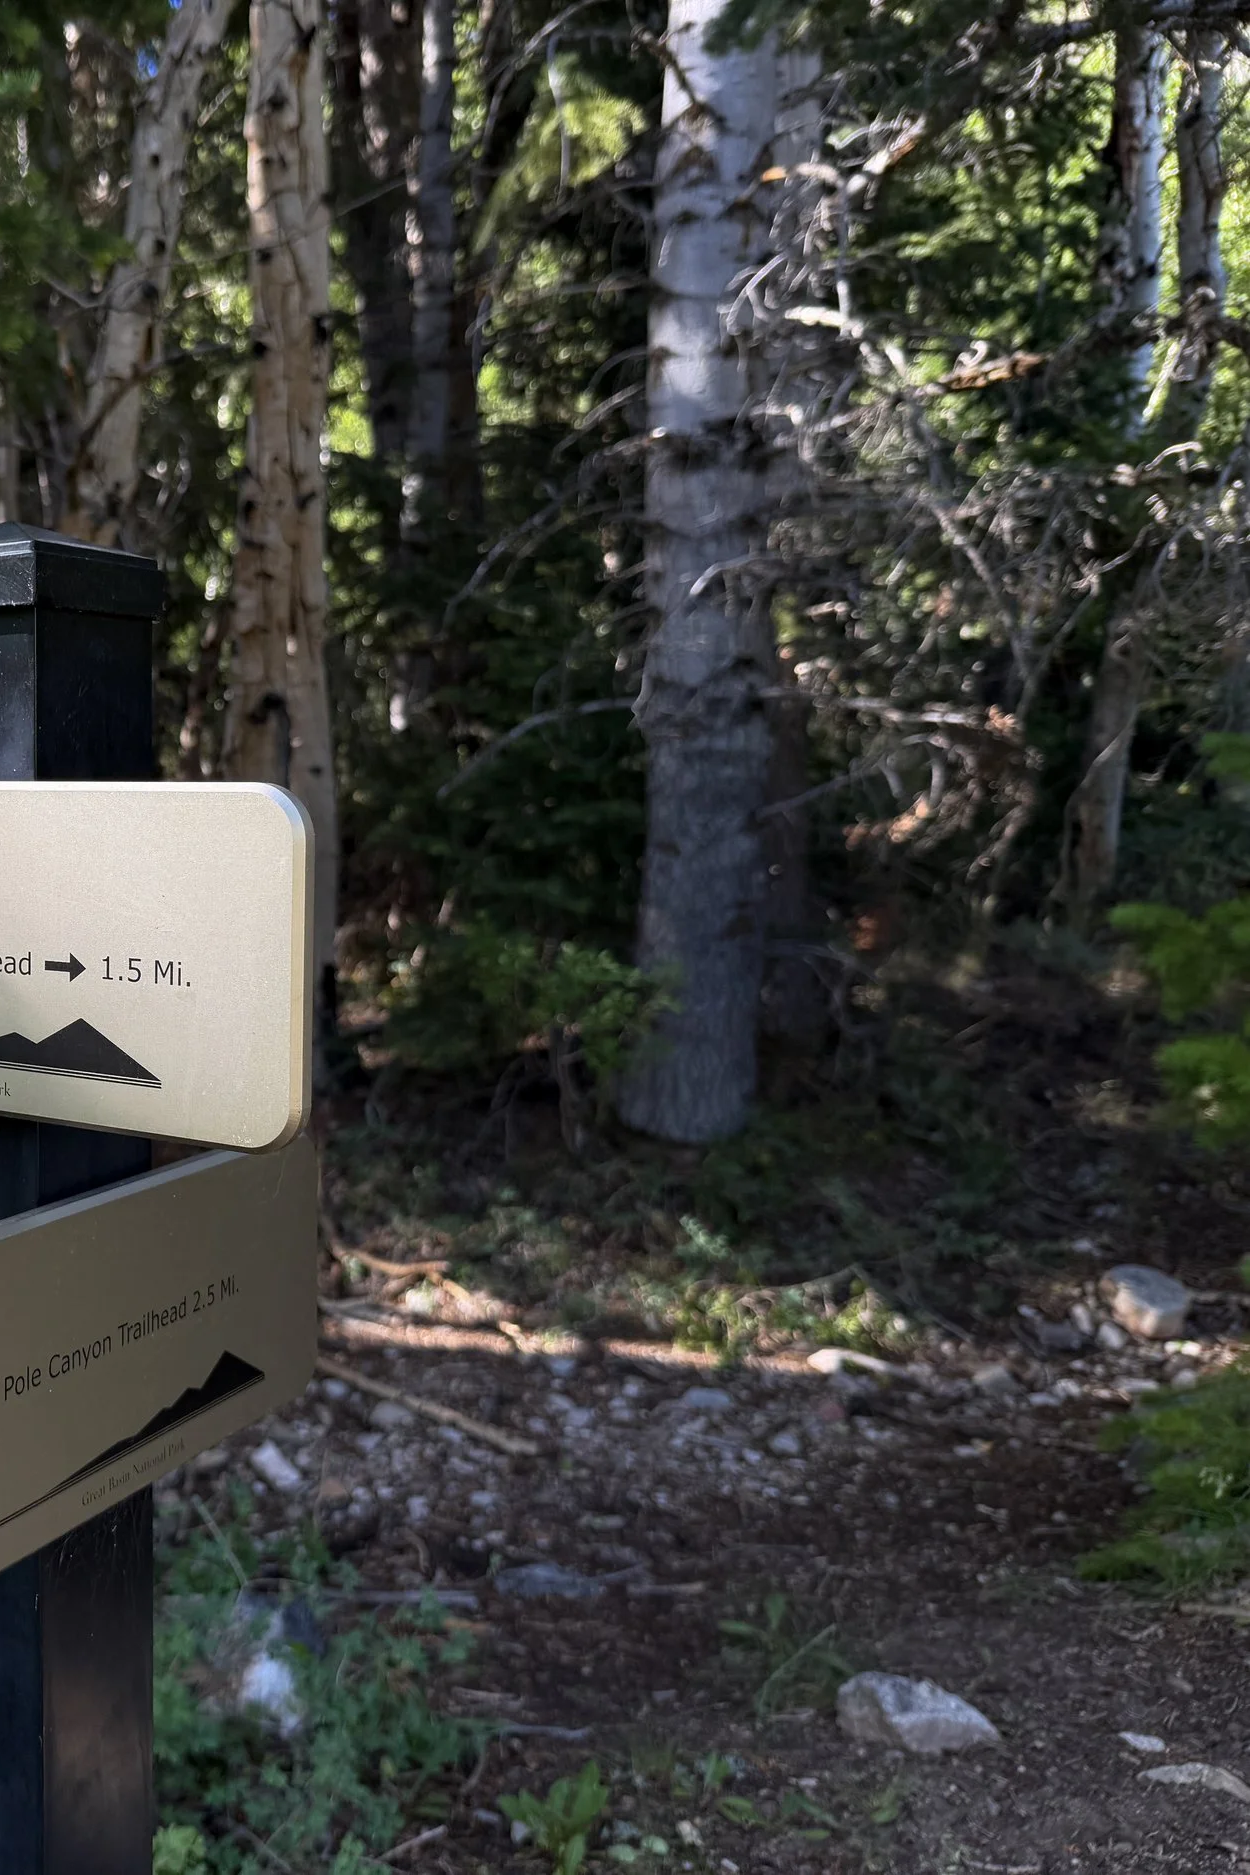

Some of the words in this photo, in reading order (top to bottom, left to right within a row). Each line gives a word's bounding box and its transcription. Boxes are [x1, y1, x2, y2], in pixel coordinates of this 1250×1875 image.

[102, 956, 142, 983] 1.5
[154, 959, 191, 987] Mi.
[4, 1366, 41, 1401] Pole
[48, 1335, 111, 1379] Canyon
[118, 1296, 187, 1347] Trailhead
[193, 1284, 215, 1313] 2.5
[221, 1275, 239, 1300] Mi.
[81, 1484, 106, 1506] Great
